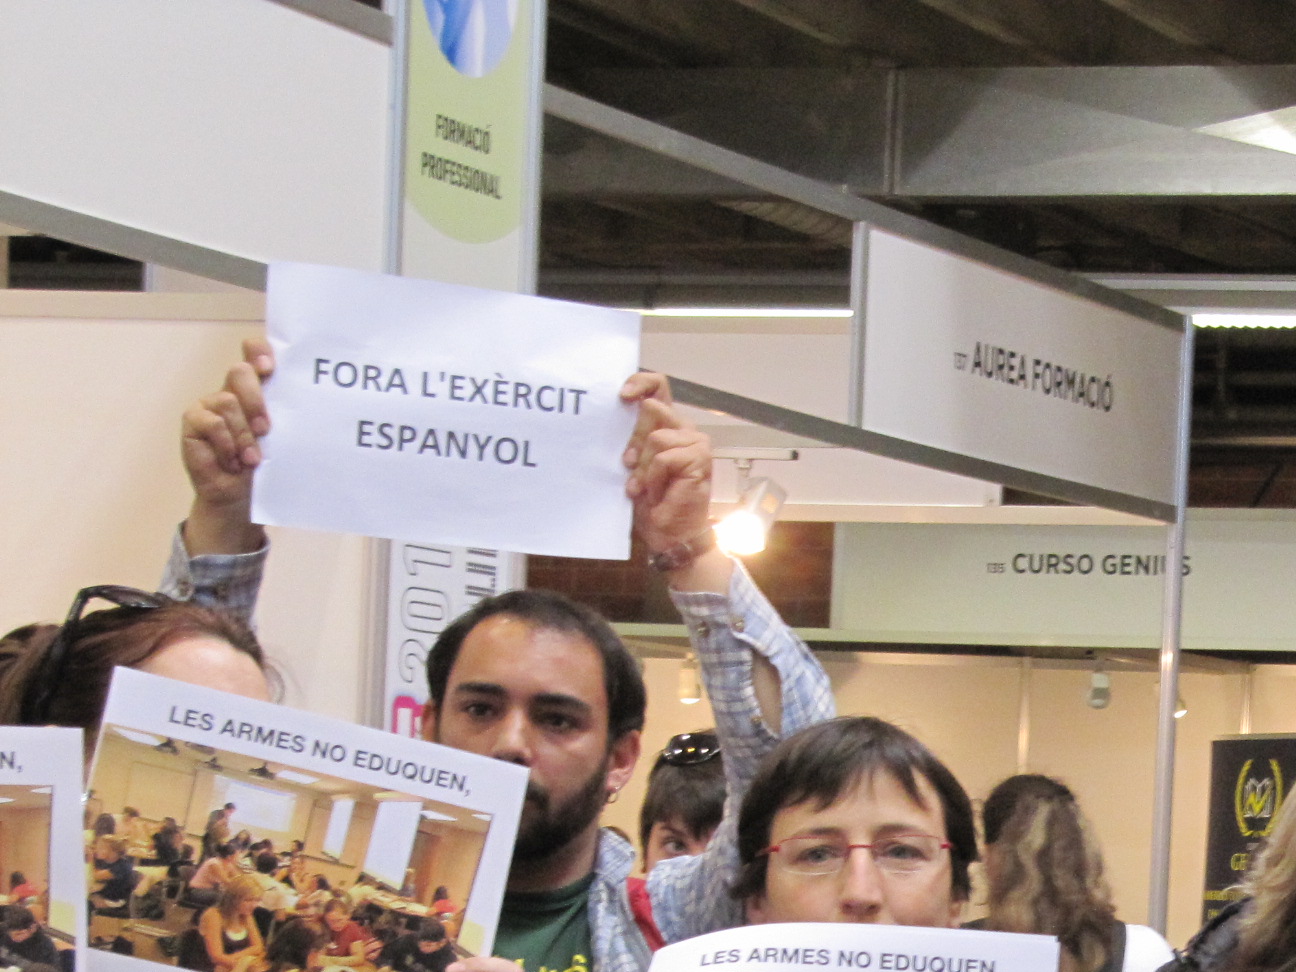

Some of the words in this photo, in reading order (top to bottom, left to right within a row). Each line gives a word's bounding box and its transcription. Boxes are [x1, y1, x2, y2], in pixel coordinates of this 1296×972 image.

[436, 114, 492, 154] FORMACIÓ
[421, 151, 502, 199] PROFESSIONAL
[313, 358, 408, 395] FORA
[421, 371, 588, 415] L'EXÈRCIT
[971, 341, 1027, 390] AUREA
[1031, 357, 1114, 413] FORMACIÓ
[356, 420, 538, 468] ESPANYOL
[1011, 553, 1094, 576] CURSO
[168, 705, 214, 731] LES
[220, 719, 305, 753] ARMES
[311, 739, 347, 762] NO
[352, 750, 473, 796] EDUQUEN,
[700, 949, 740, 967] LES
[746, 948, 830, 966] ARMES
[837, 950, 872, 969] NO
